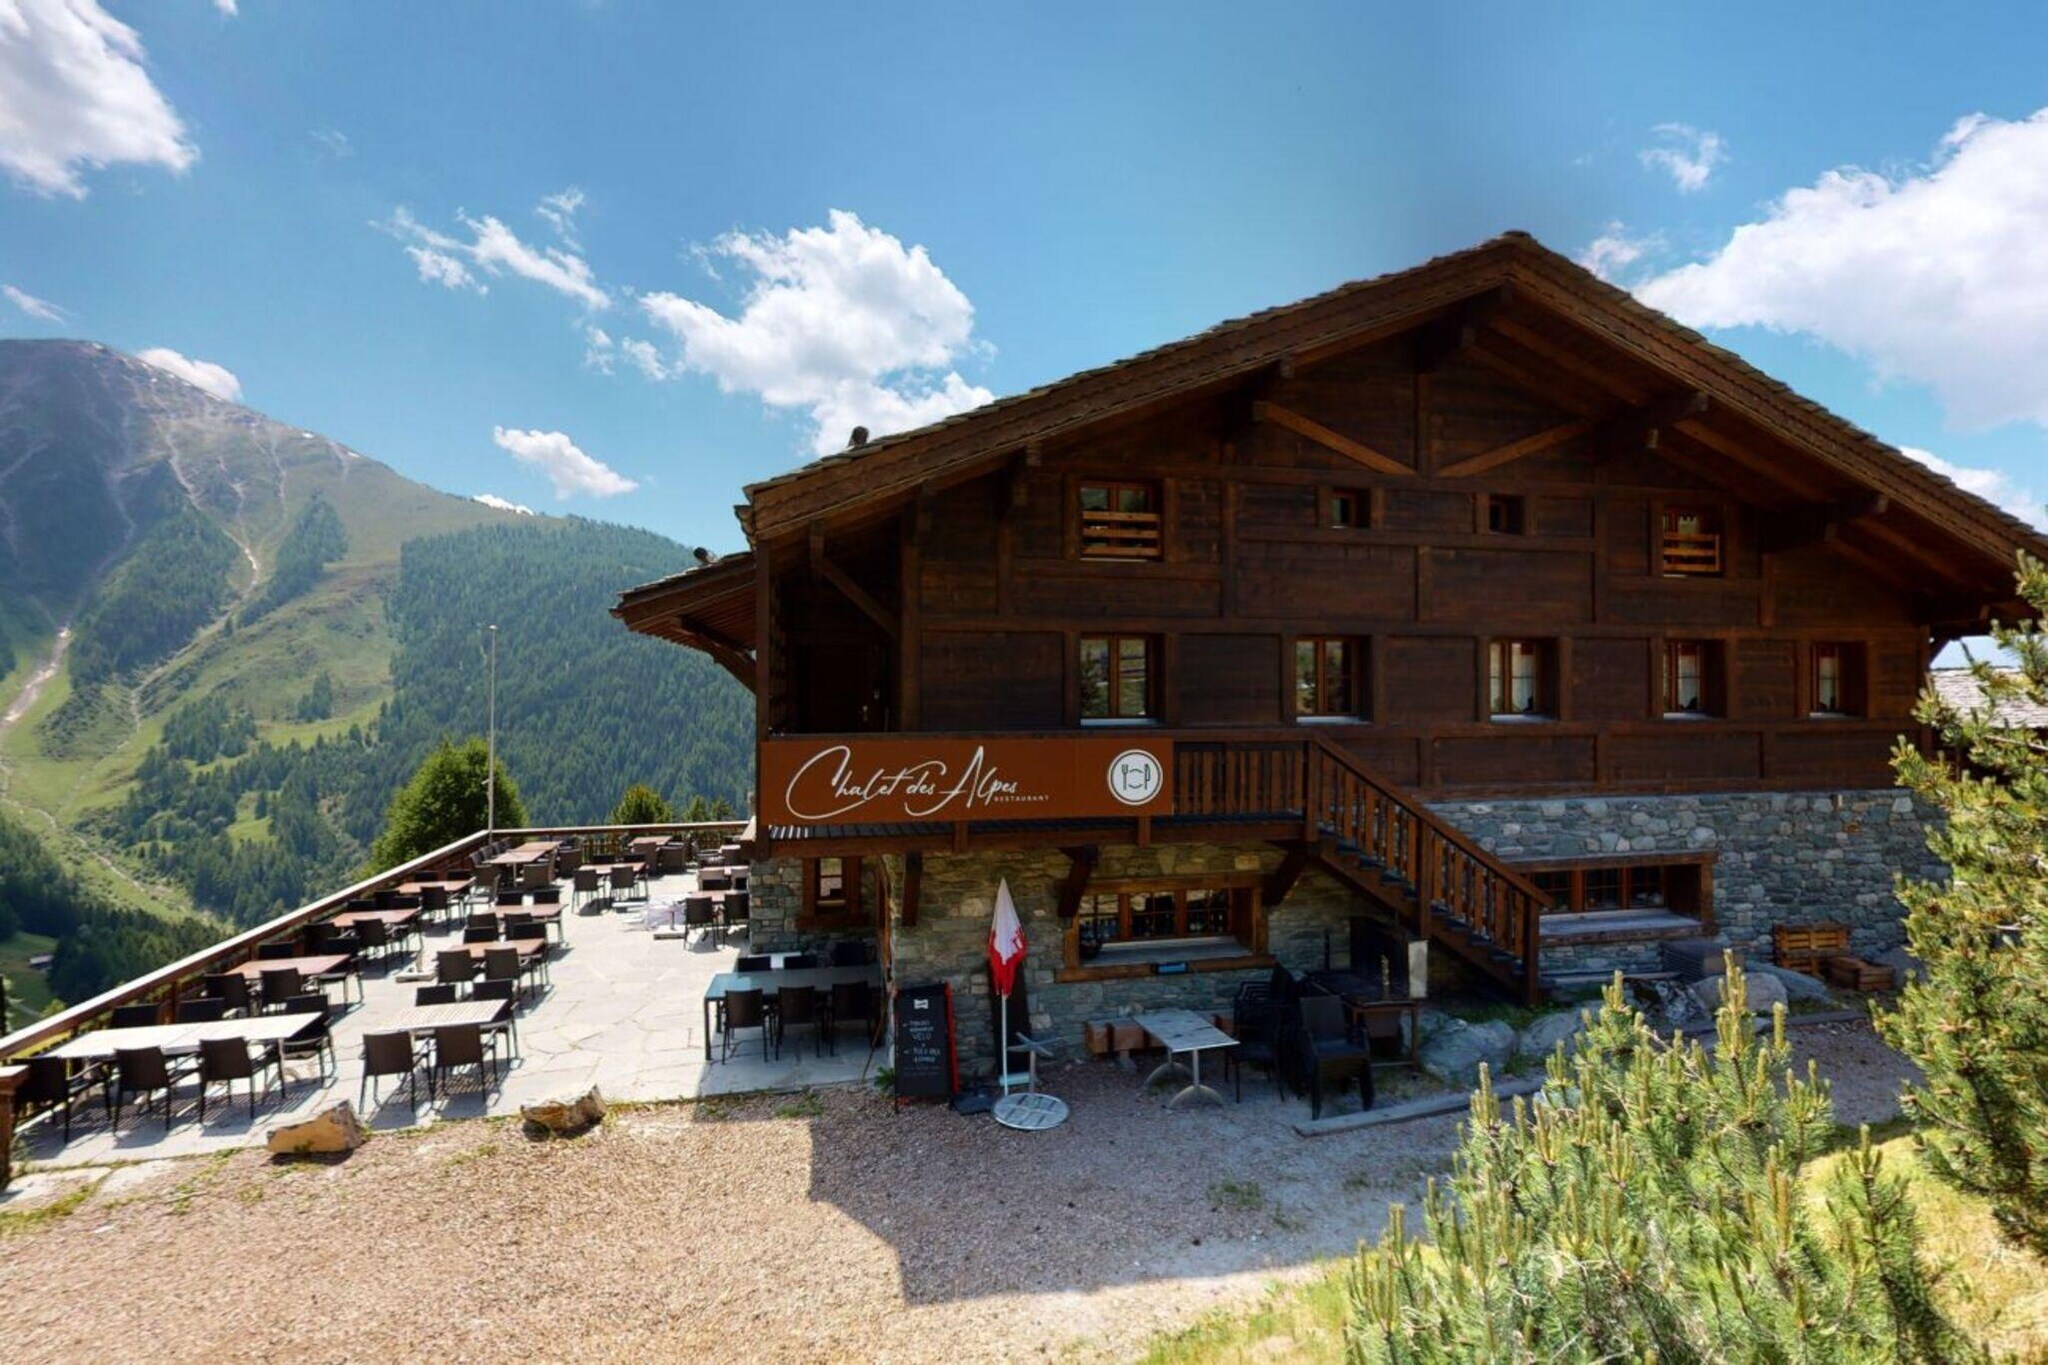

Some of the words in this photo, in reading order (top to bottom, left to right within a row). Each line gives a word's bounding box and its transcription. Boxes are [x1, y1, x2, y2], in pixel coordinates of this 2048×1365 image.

[786, 745, 914, 819] Chalet
[904, 746, 1017, 816] Alpes
[905, 761, 946, 795] des
[994, 794, 1050, 802] RESTAURANT
